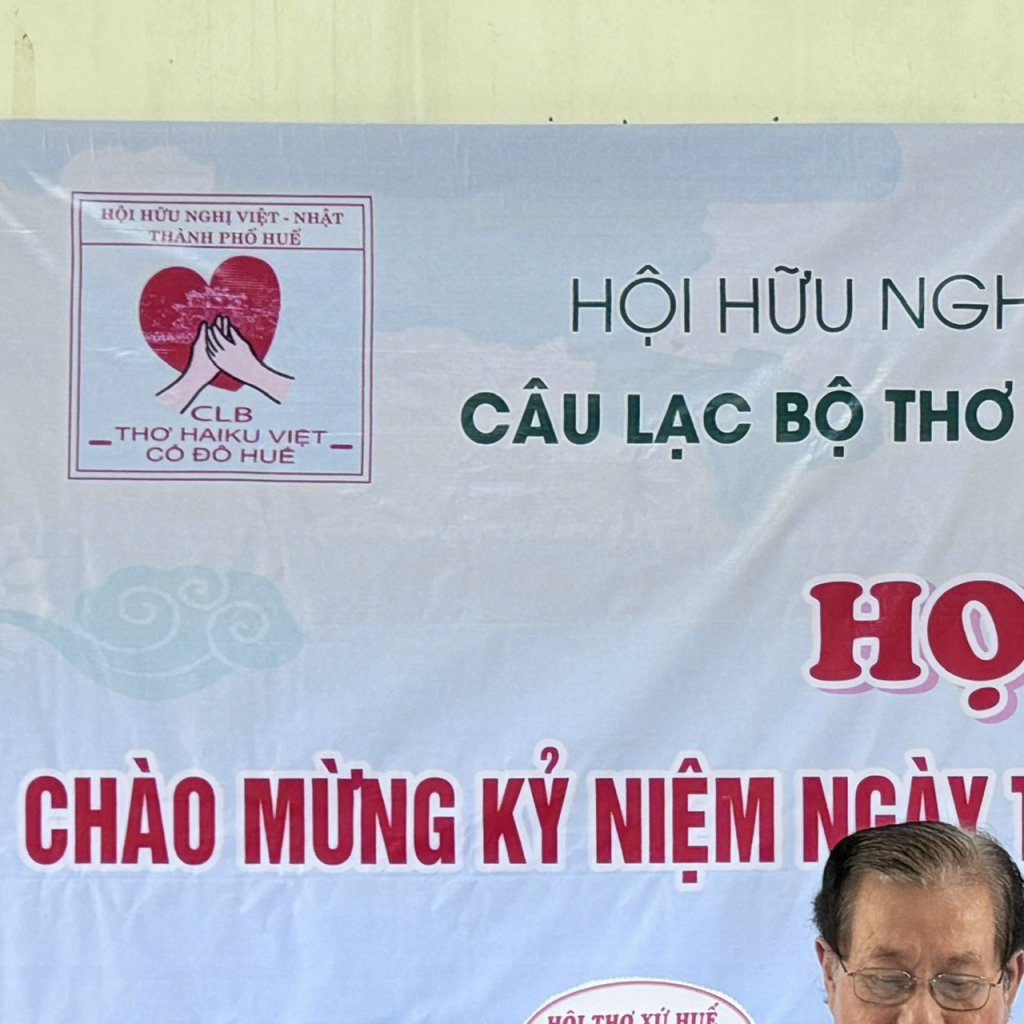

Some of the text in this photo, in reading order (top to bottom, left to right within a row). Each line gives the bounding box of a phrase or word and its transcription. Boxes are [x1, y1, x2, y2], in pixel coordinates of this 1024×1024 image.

[101, 206, 135, 224] HỘI
[141, 206, 180, 223] HỮU
[185, 210, 231, 227] NGHỊ
[236, 208, 279, 227] VIỆT
[294, 208, 344, 228] NHẬT
[149, 227, 302, 246] THÀNH PHỐ HUẾ
[572, 264, 691, 346] HỘI
[720, 265, 853, 334] HỮU
[191, 406, 253, 423] CLB
[461, 377, 600, 445] CÂU
[627, 392, 752, 460] LẠC
[776, 376, 864, 457] BỘ
[885, 380, 1014, 442] THƠ
[114, 426, 328, 447] THƠ HAIKU VIỆT
[192, 445, 232, 463] ĐÔ
[25, 757, 216, 866] CHÀO
[243, 758, 456, 866] MỪNG
[482, 746, 570, 864] KỶ
[594, 756, 775, 883] NIỆM
[802, 756, 989, 862] NGÀY
